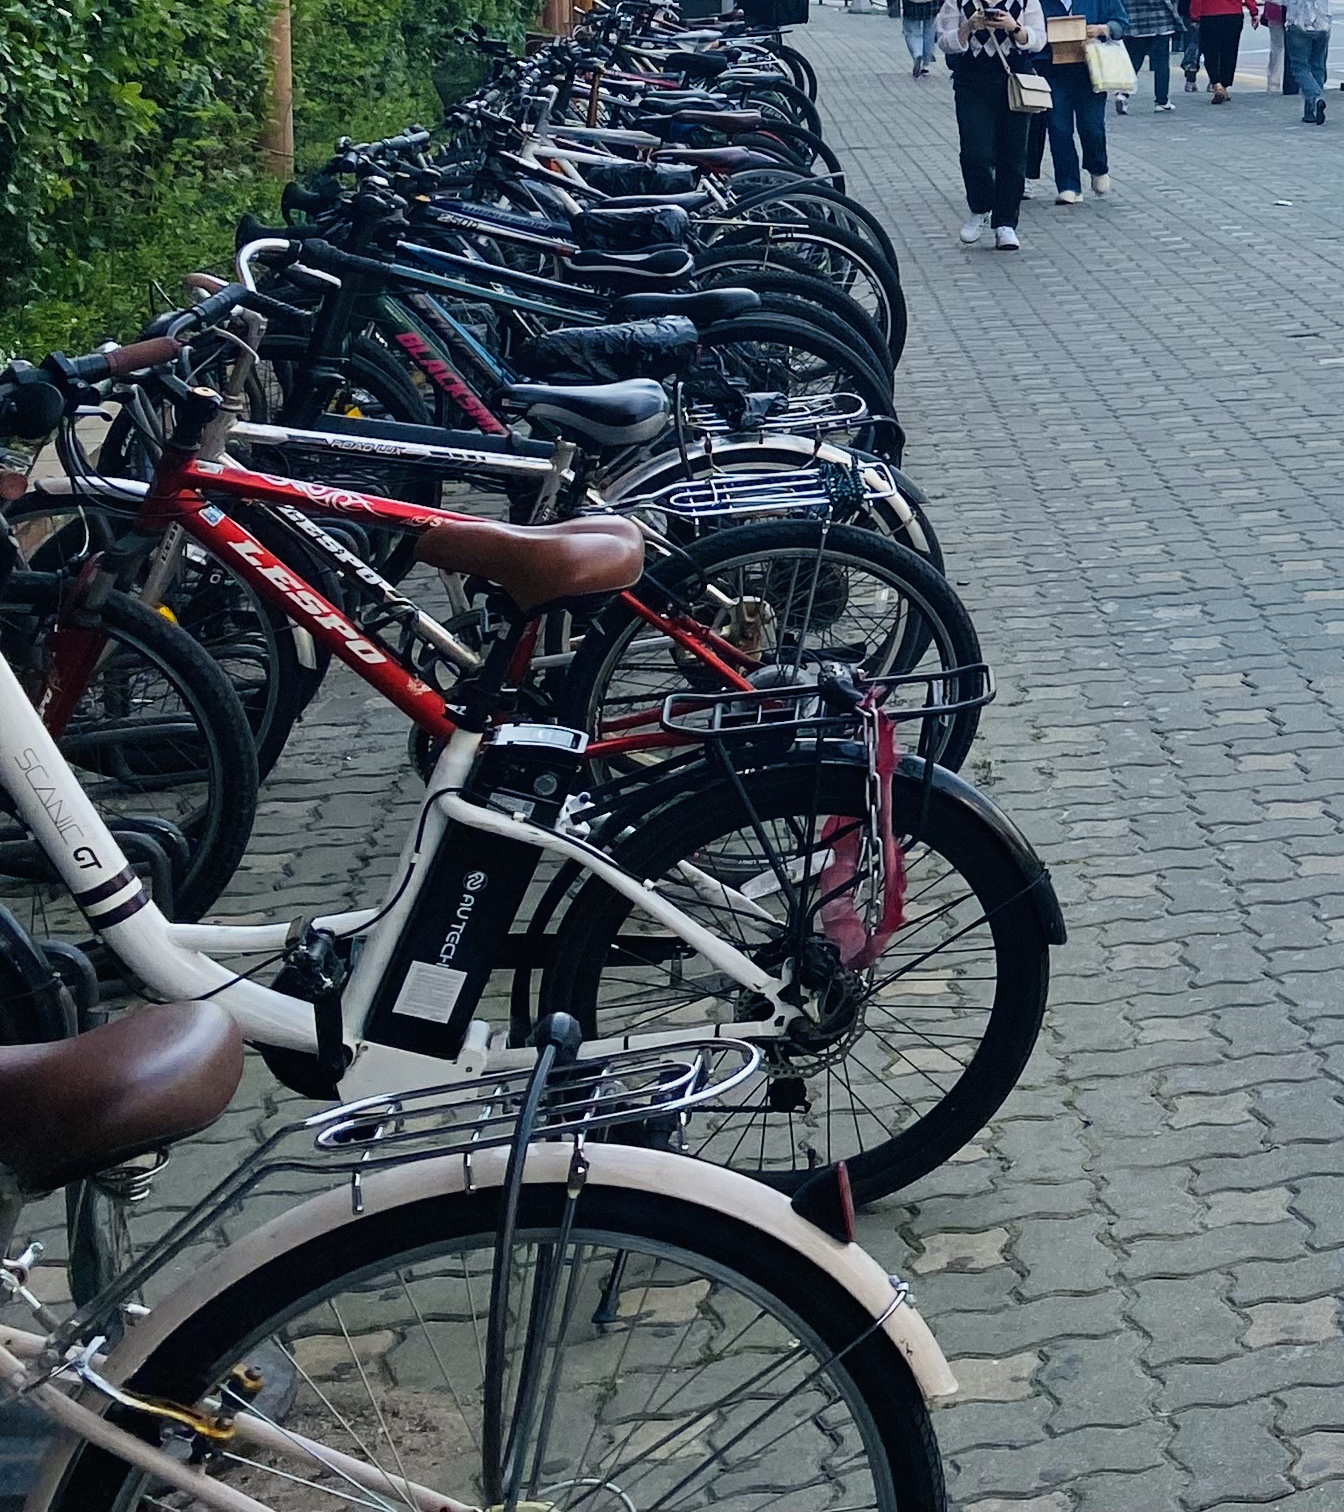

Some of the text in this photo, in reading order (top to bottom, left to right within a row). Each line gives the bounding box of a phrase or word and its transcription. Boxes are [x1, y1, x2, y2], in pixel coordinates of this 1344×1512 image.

[330, 439, 373, 453] ROAD
[227, 540, 387, 664] LESPO
[14, 747, 103, 870] SCANIC GT
[435, 893, 476, 968] AUTECH
